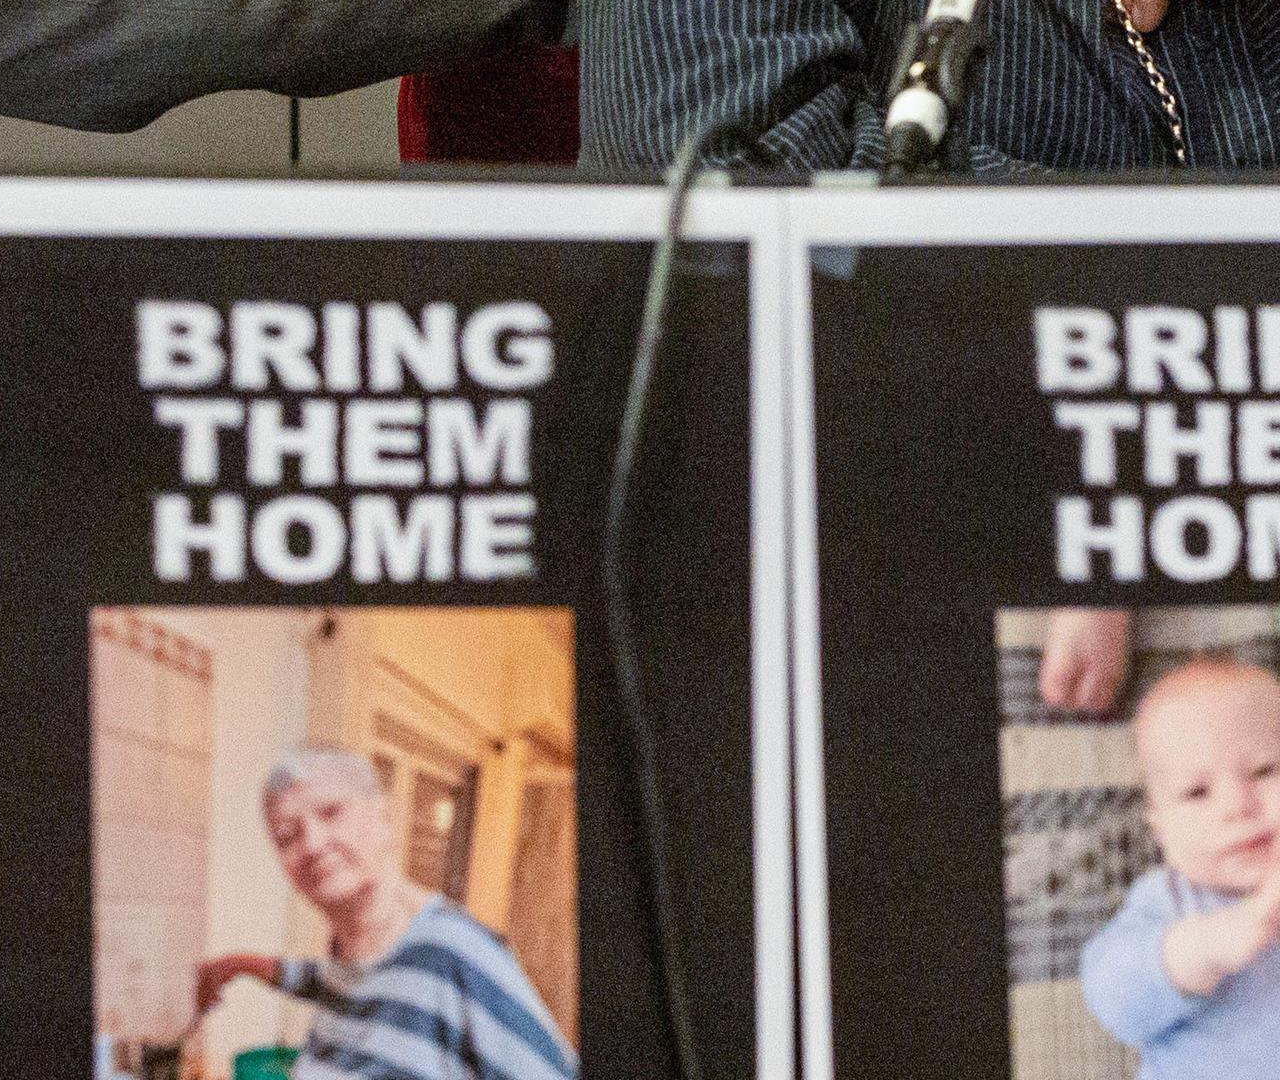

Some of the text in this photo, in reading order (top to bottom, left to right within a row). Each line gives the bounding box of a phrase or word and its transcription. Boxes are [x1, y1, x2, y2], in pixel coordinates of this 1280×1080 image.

[136, 300, 554, 392] BRING
[154, 397, 531, 487] THEM
[153, 494, 536, 584] HOME
